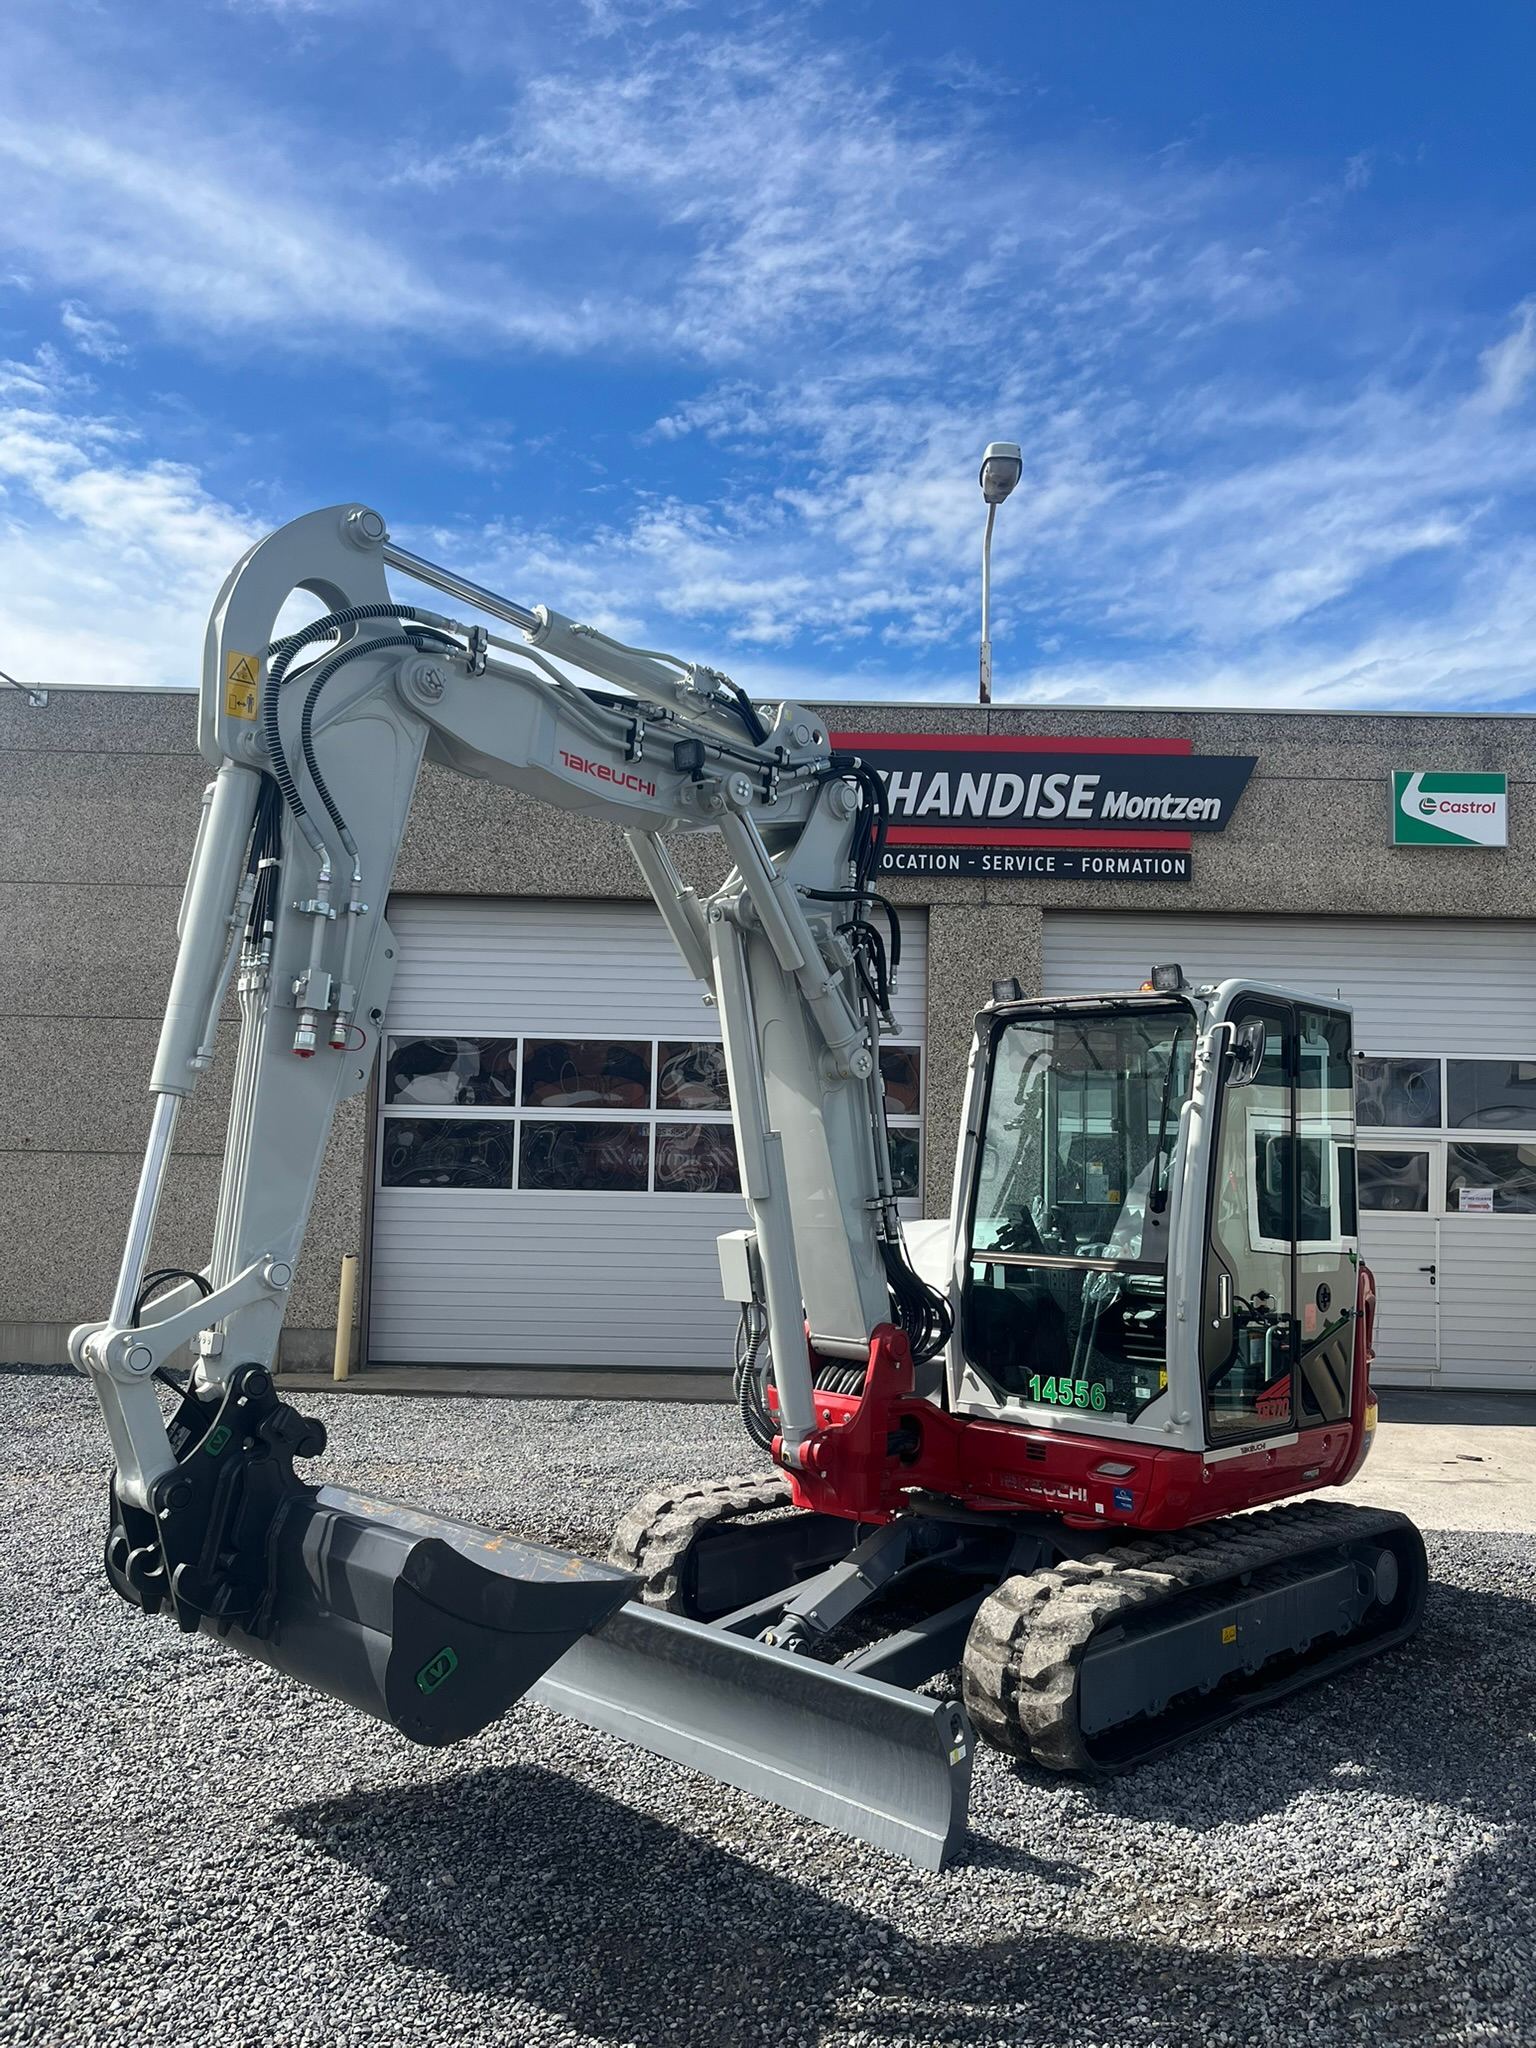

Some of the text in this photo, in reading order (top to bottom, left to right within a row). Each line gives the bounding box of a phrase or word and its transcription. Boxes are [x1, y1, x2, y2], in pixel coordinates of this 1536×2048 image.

[559, 750, 656, 797] TAKEUCHI
[857, 770, 1221, 822] HANDISE Montzen
[1439, 801, 1496, 814] Castrol
[879, 853, 961, 872] OCATION
[982, 854, 1056, 873] SERVICE
[1081, 857, 1186, 875] FORMATION
[1029, 1374, 1106, 1411] 14556
